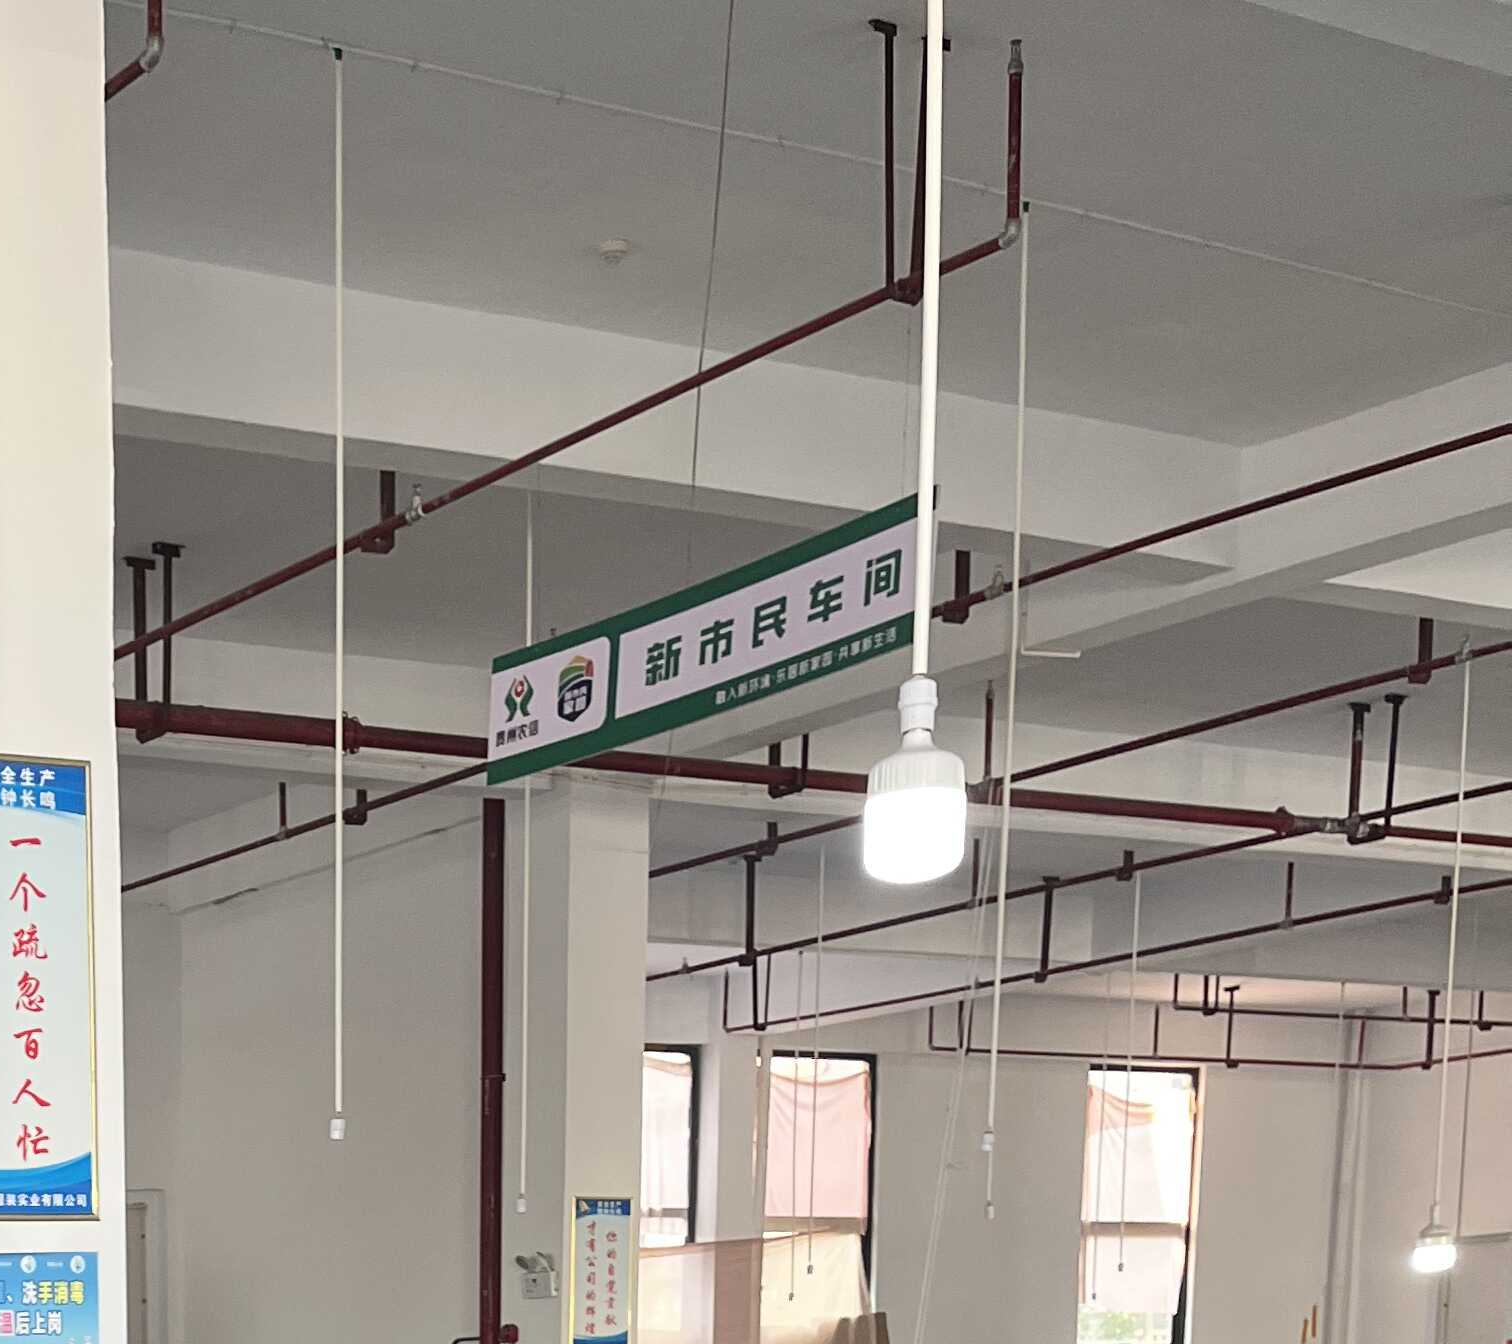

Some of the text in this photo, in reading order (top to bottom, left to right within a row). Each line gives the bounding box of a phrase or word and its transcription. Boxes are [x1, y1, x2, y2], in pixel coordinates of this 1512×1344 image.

[645, 548, 903, 686] 新市民车间
[495, 720, 539, 747] 贵州农信
[9, 834, 51, 1162] 一个疏忽百人忙
